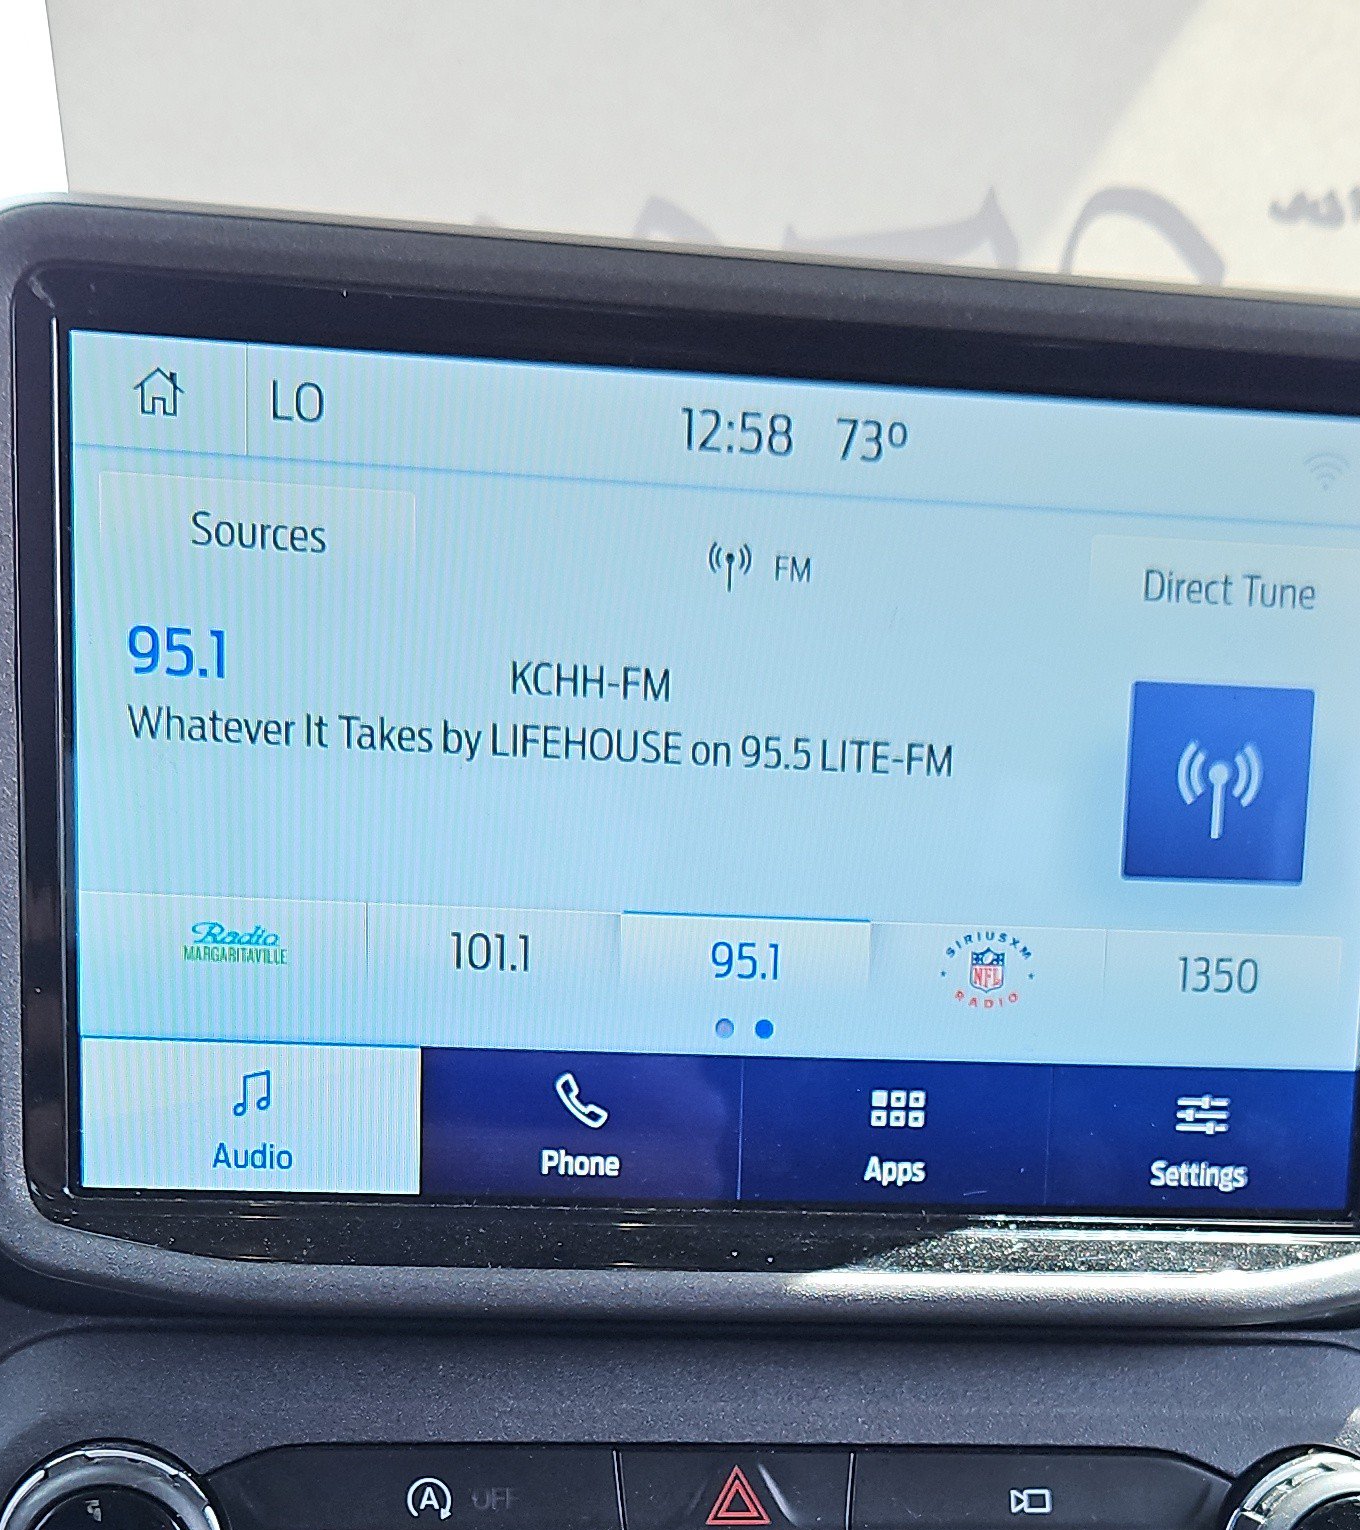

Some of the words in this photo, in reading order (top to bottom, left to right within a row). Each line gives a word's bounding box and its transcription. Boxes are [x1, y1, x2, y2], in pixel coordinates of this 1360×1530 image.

[272, 379, 324, 423] LO
[682, 407, 793, 456] 12:58
[191, 510, 326, 553] Sources
[775, 555, 811, 582] FM
[1144, 568, 1233, 606] Direct
[1243, 574, 1316, 610] Tune
[128, 625, 225, 679] 95.1
[511, 660, 670, 702] KCHH-FM
[127, 704, 296, 746] Whatever
[306, 713, 328, 748] It
[338, 714, 433, 753] Takes
[442, 719, 482, 762] by
[491, 722, 682, 765] LIFEHOUSE
[691, 741, 731, 767] on
[741, 735, 811, 771] 95.5
[821, 739, 953, 777] LITE-FM
[191, 921, 280, 946] Radio
[946, 931, 1032, 960] SIRIUSXM
[183, 945, 288, 965] MARGARITAVILLE
[451, 931, 529, 972] 101.1
[711, 941, 779, 981] 95.1
[974, 967, 1001, 988] NFL
[1179, 956, 1259, 994] 1350
[955, 990, 1018, 1008] RADIO
[212, 1142, 293, 1170] Audio
[541, 1149, 620, 1176] Phone
[863, 1155, 926, 1187] Apps
[1150, 1160, 1248, 1192] Settings
